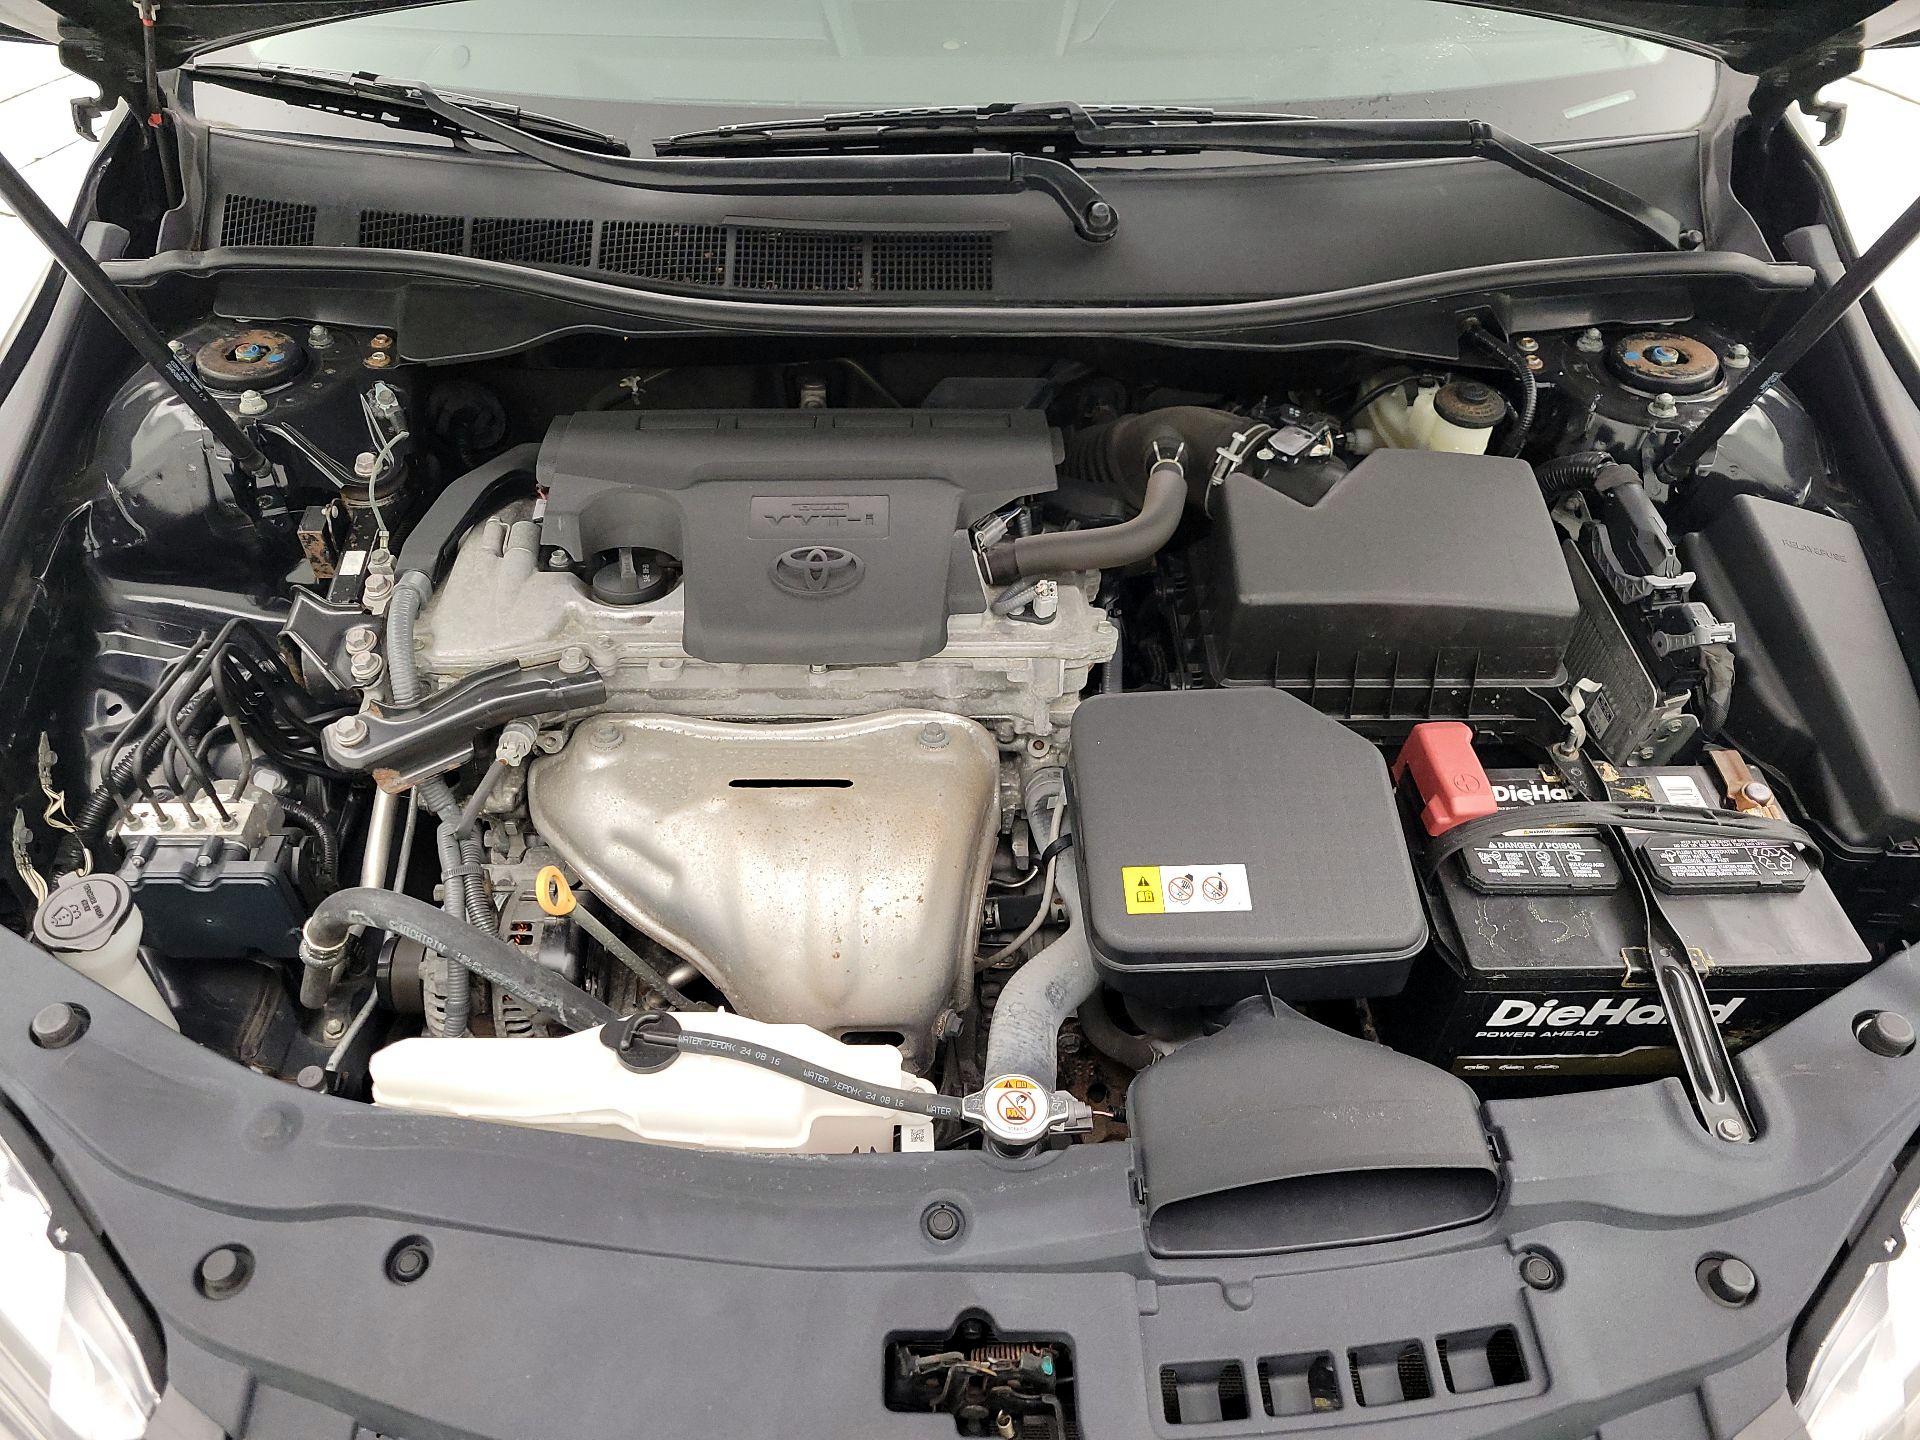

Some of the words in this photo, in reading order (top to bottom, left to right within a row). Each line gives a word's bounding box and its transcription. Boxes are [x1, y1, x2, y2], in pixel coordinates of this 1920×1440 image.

[1497, 841, 1537, 849] DANGER
[1486, 997, 1746, 1026] DieHad
[1540, 1030, 1600, 1038] AHEAD
[678, 1034, 703, 1046] WATER
[740, 1046, 752, 1056] 24
[755, 1051, 767, 1061] 08
[770, 1056, 781, 1066] 16
[803, 1068, 829, 1085] WATER
[865, 1091, 877, 1101] 24
[880, 1095, 891, 1105] 08
[894, 1098, 905, 1108] 16
[926, 1103, 952, 1116] WATER
